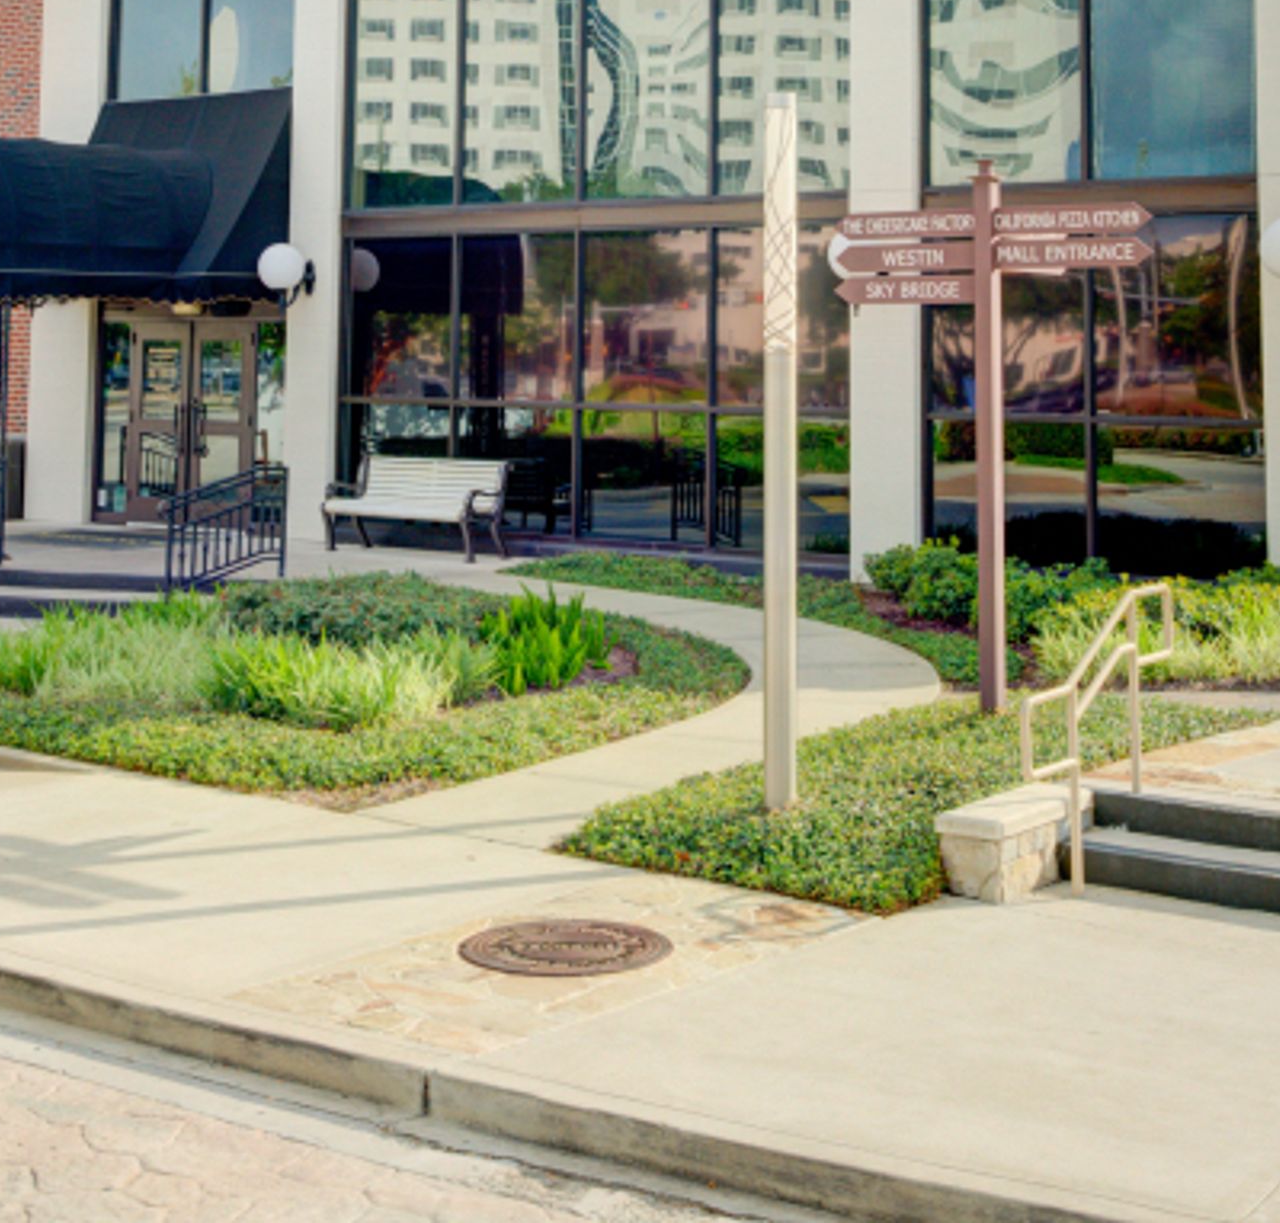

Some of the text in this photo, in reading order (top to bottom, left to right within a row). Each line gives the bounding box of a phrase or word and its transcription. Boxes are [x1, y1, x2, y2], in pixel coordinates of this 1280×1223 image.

[842, 217, 863, 234] THE
[1059, 210, 1089, 229] PIZZA
[882, 248, 945, 267] WESTIN
[997, 242, 1136, 263] MALL ENTRANCE
[866, 280, 960, 299] SKY BRIDGE
